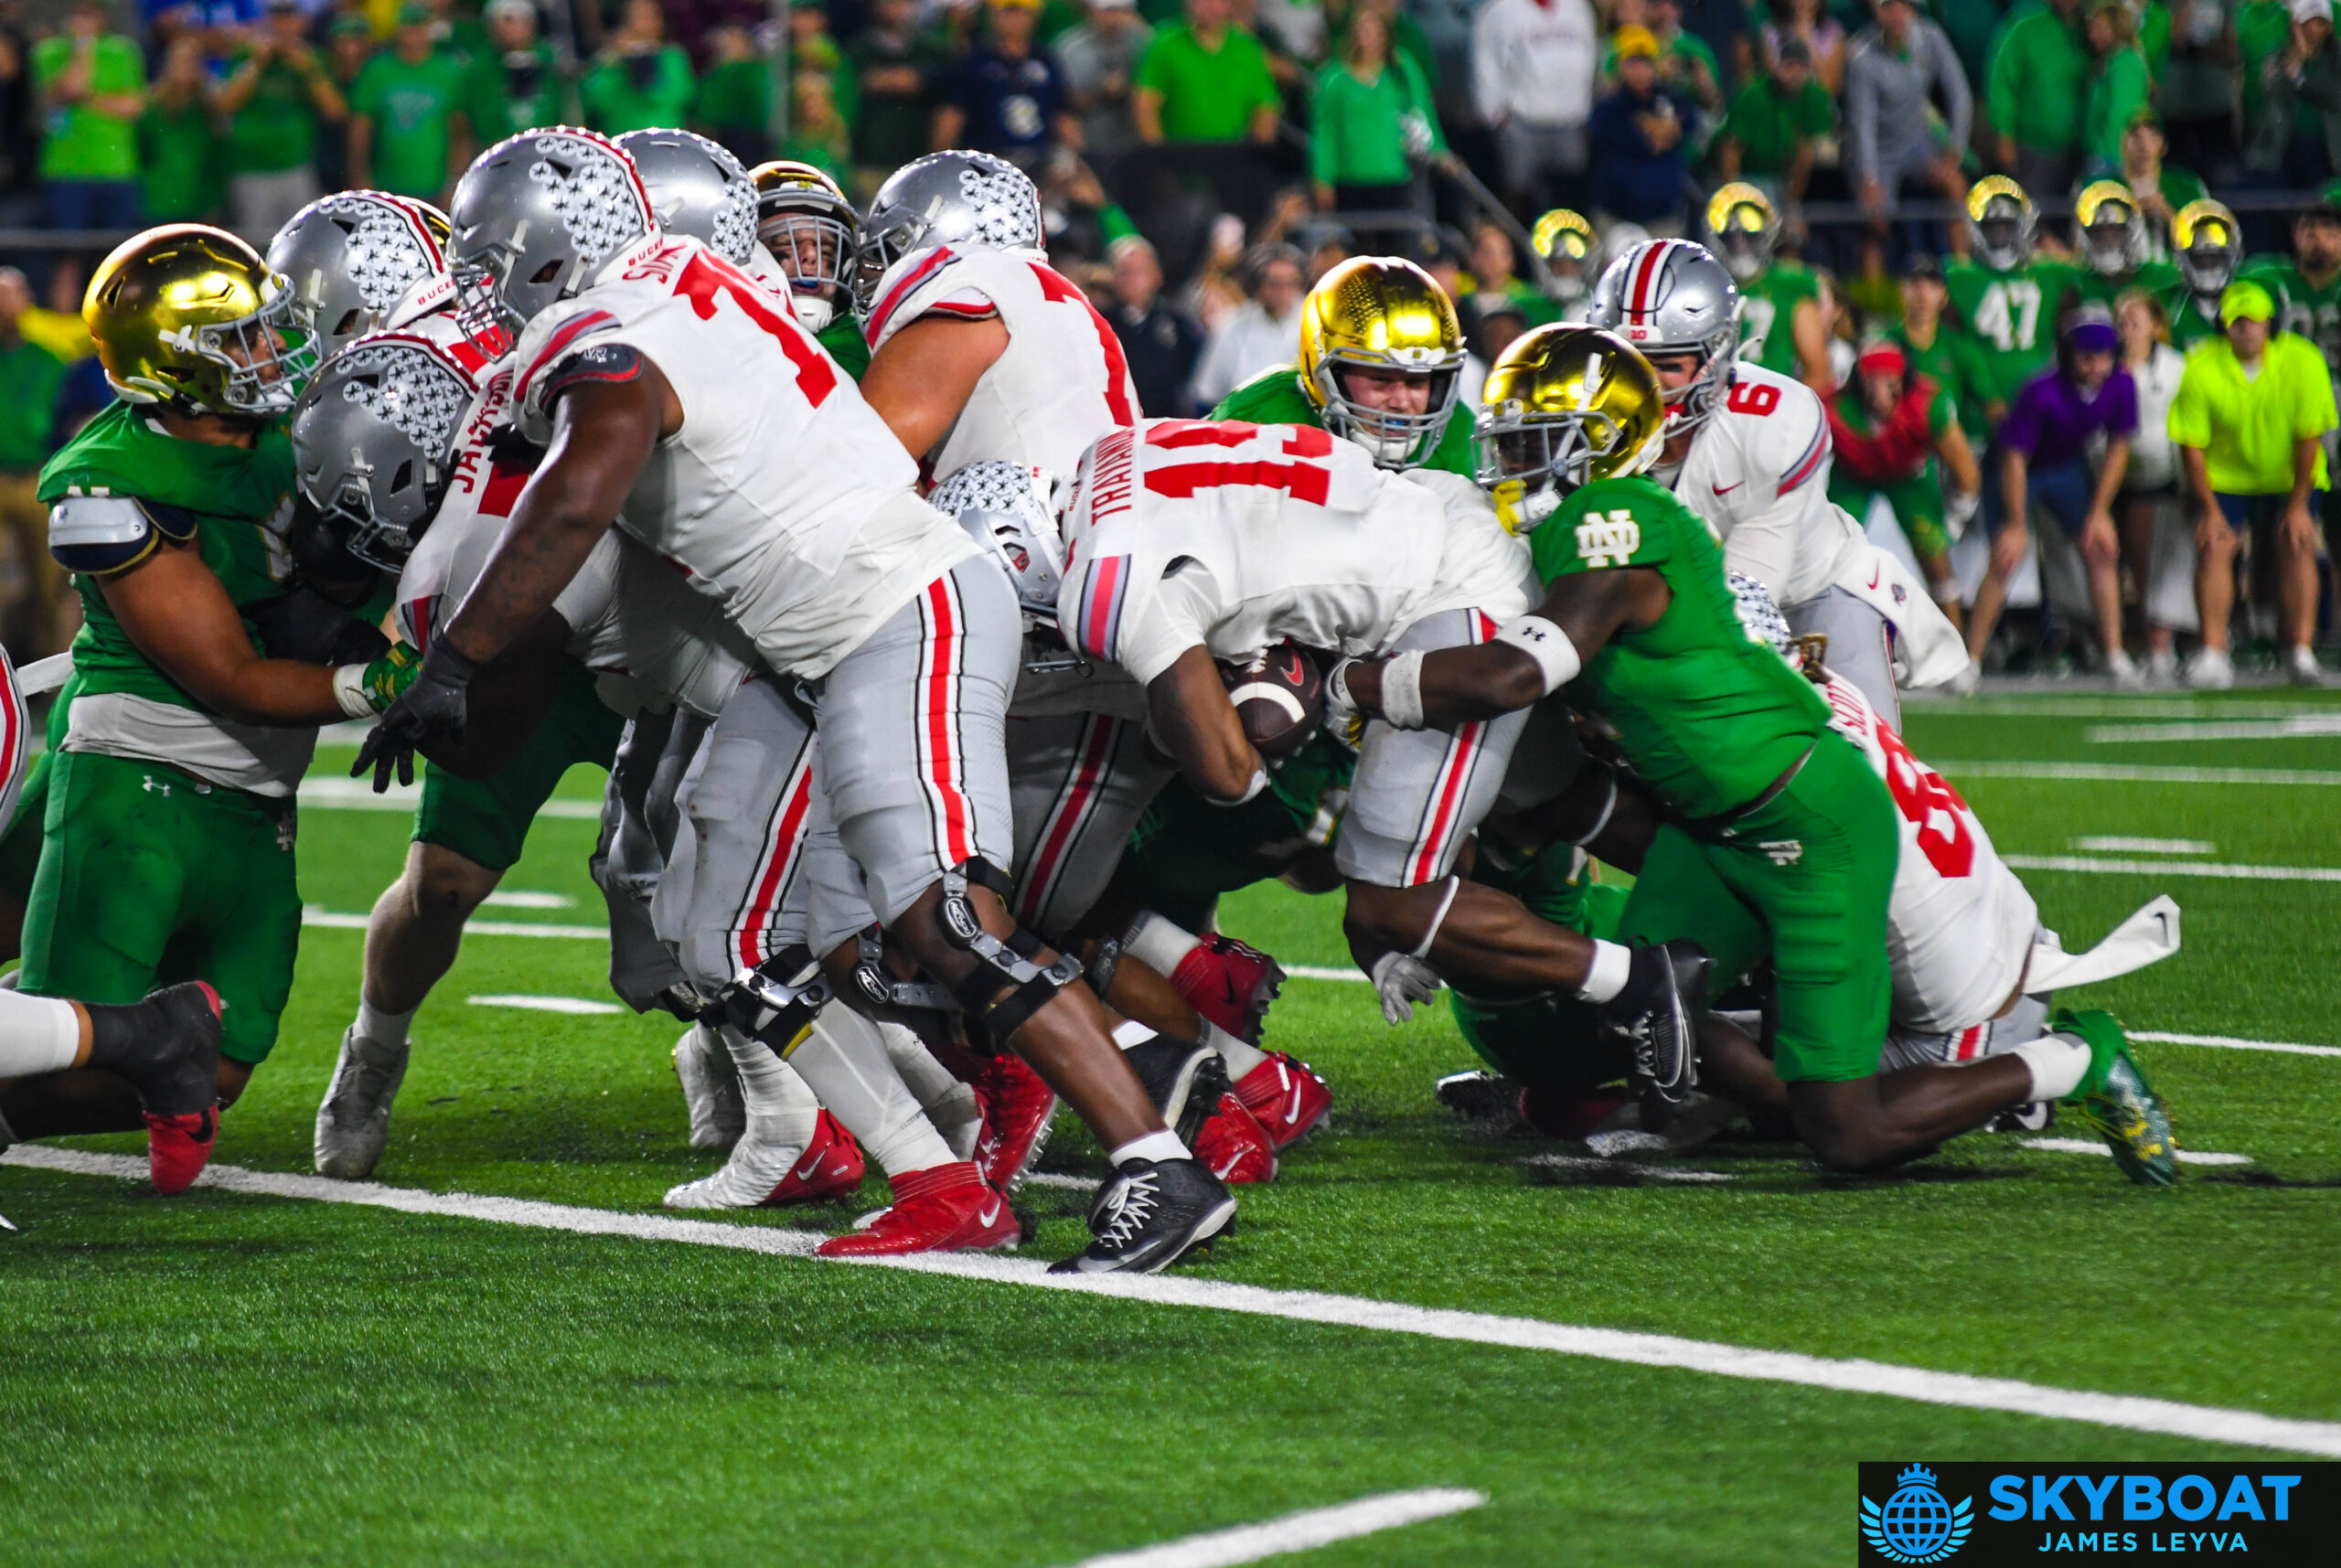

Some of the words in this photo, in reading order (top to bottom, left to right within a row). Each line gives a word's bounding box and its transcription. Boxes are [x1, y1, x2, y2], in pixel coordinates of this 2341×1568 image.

[672, 248, 839, 410] 7
[1974, 280, 2042, 352] 47
[1727, 382, 1782, 417] 6
